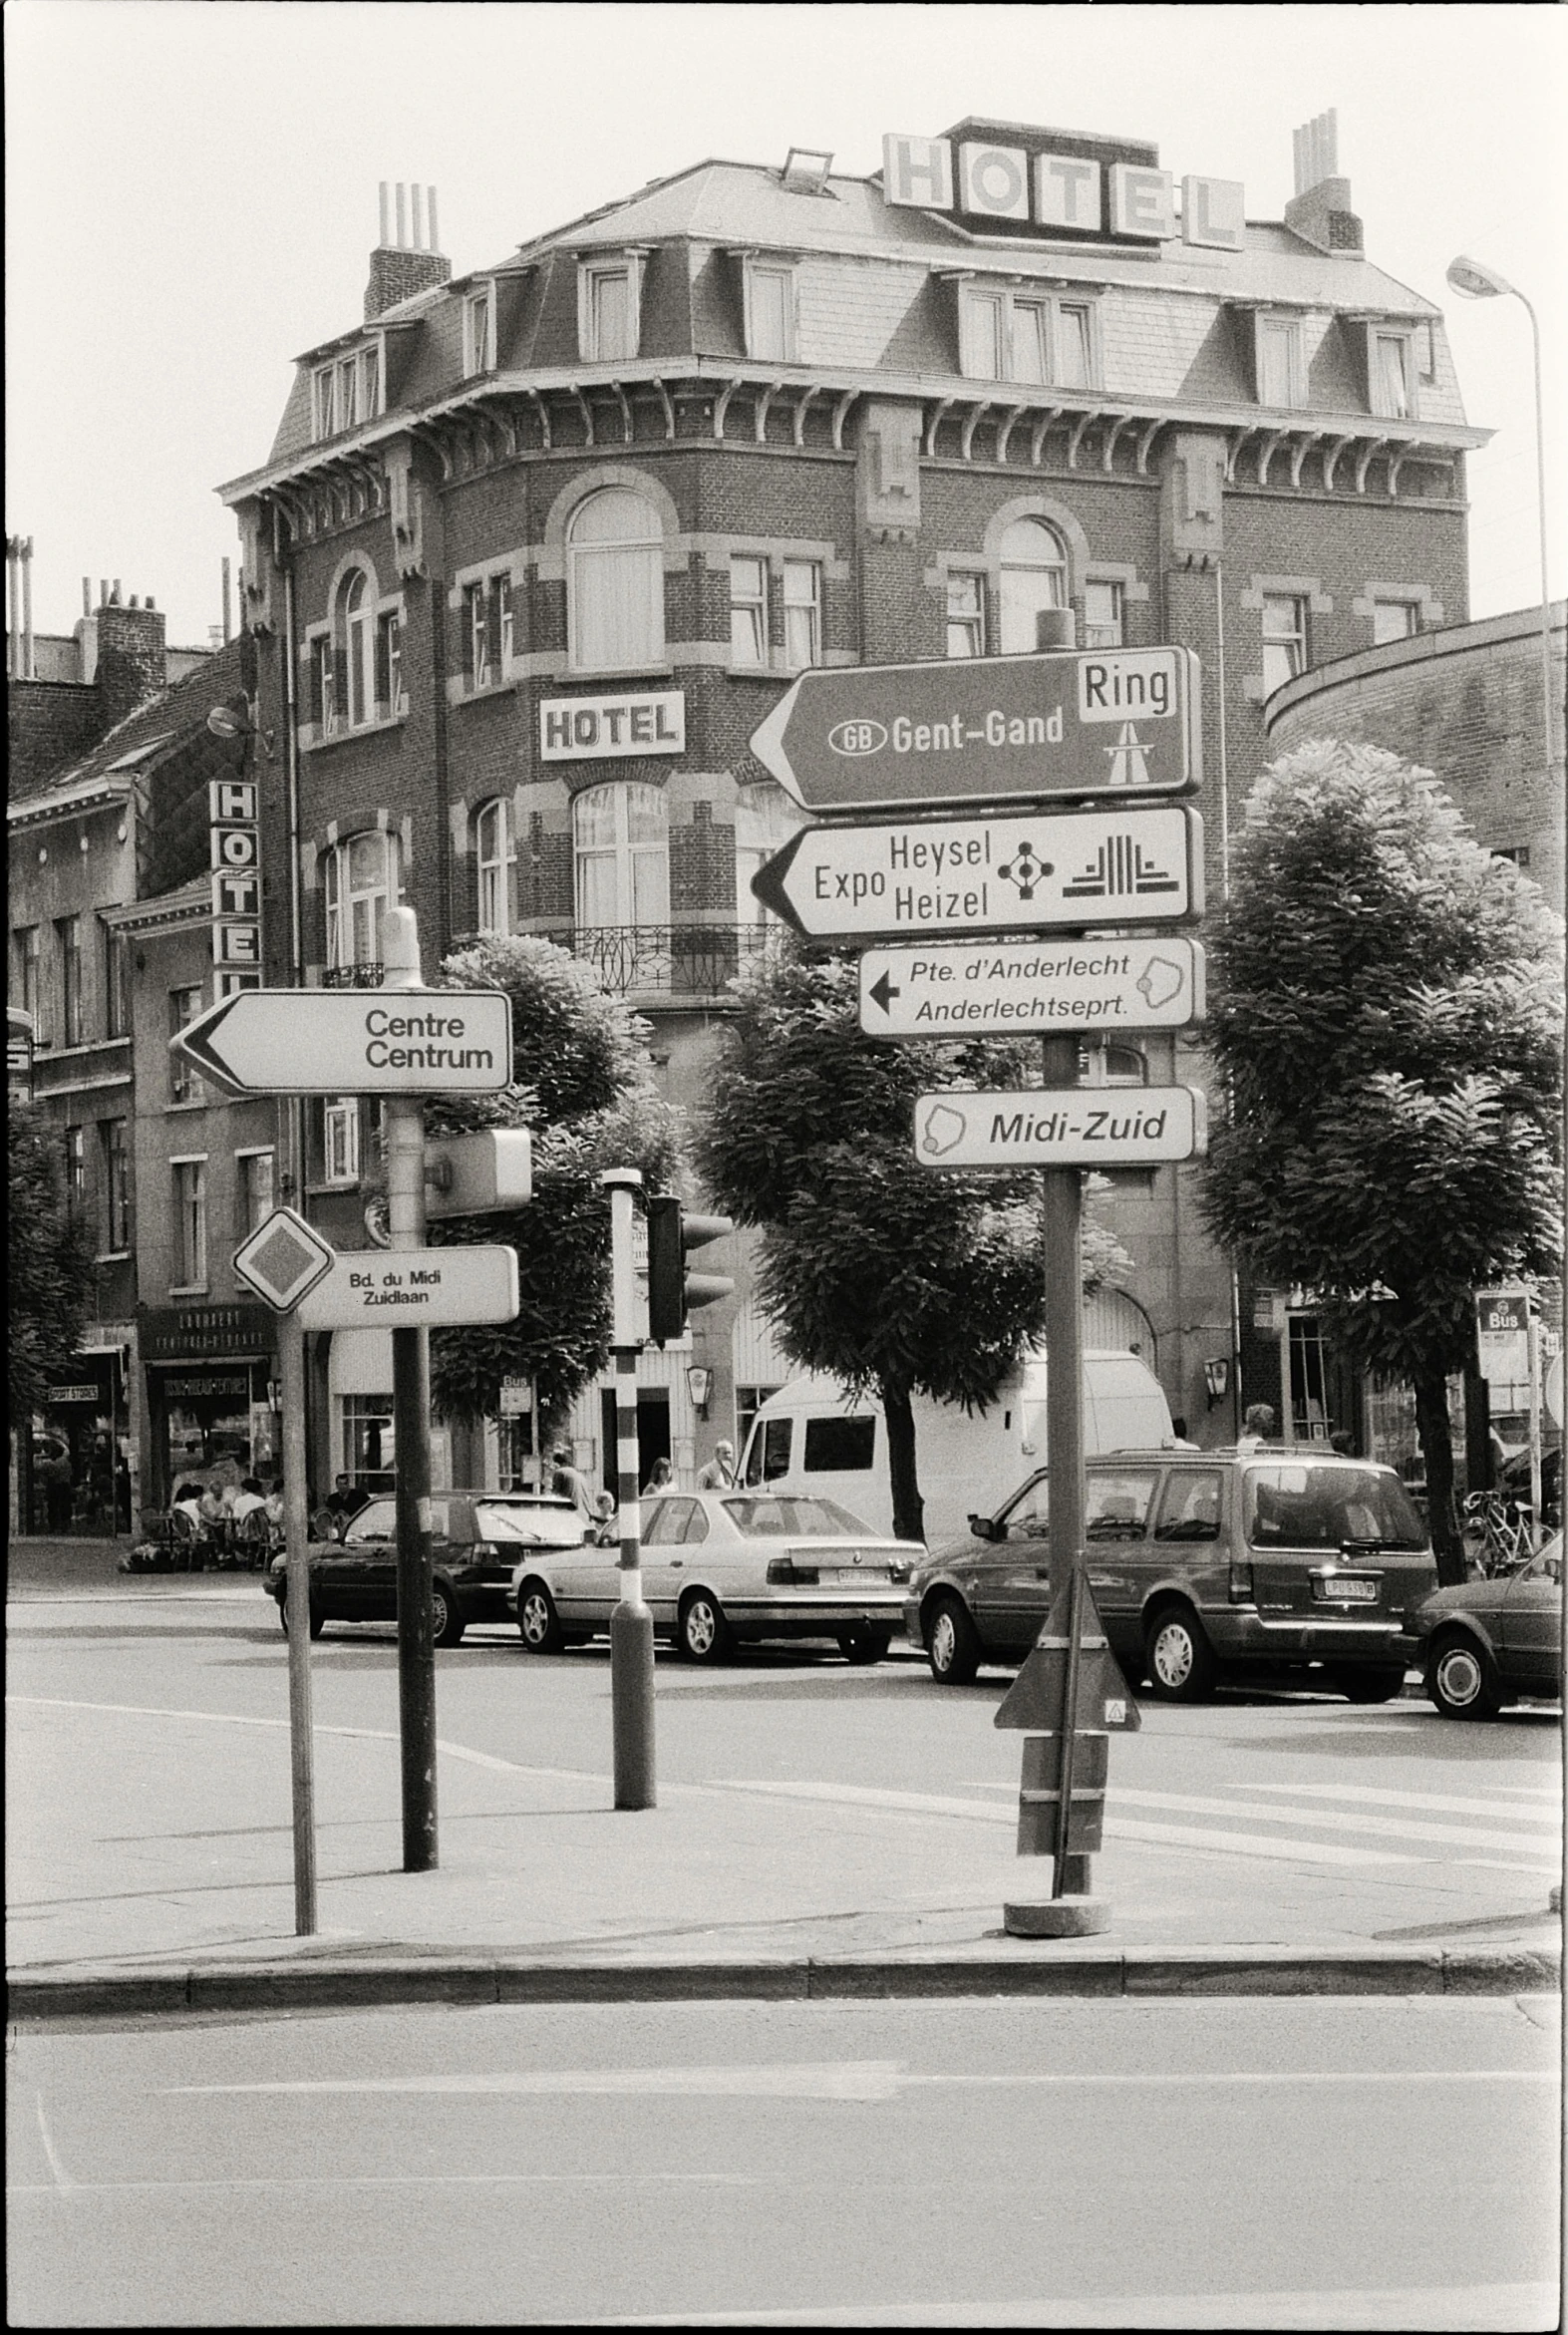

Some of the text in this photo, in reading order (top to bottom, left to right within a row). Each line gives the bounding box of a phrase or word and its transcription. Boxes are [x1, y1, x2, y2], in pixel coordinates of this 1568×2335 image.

[897, 141, 1237, 244] HOTEL
[1085, 664, 1169, 716] Ring
[546, 703, 680, 749] HOTEL
[843, 705, 1065, 753] GB Gent-Gand
[890, 830, 991, 877] Heysel
[814, 864, 885, 907] Expo
[895, 881, 988, 921] Heizel
[909, 954, 1131, 983] Pte. d'Anderlecht
[365, 1008, 466, 1038] Centre
[914, 995, 1128, 1022] Anderlechtseprt.
[365, 1040, 493, 1069] Centrum
[989, 1109, 1167, 1144] Midi-Zuid
[350, 1269, 442, 1288] Bd. du Midi
[363, 1289, 430, 1306] Zuidlaan
[1488, 1311, 1519, 1329] Bus
[503, 1375, 528, 1388] Bus
